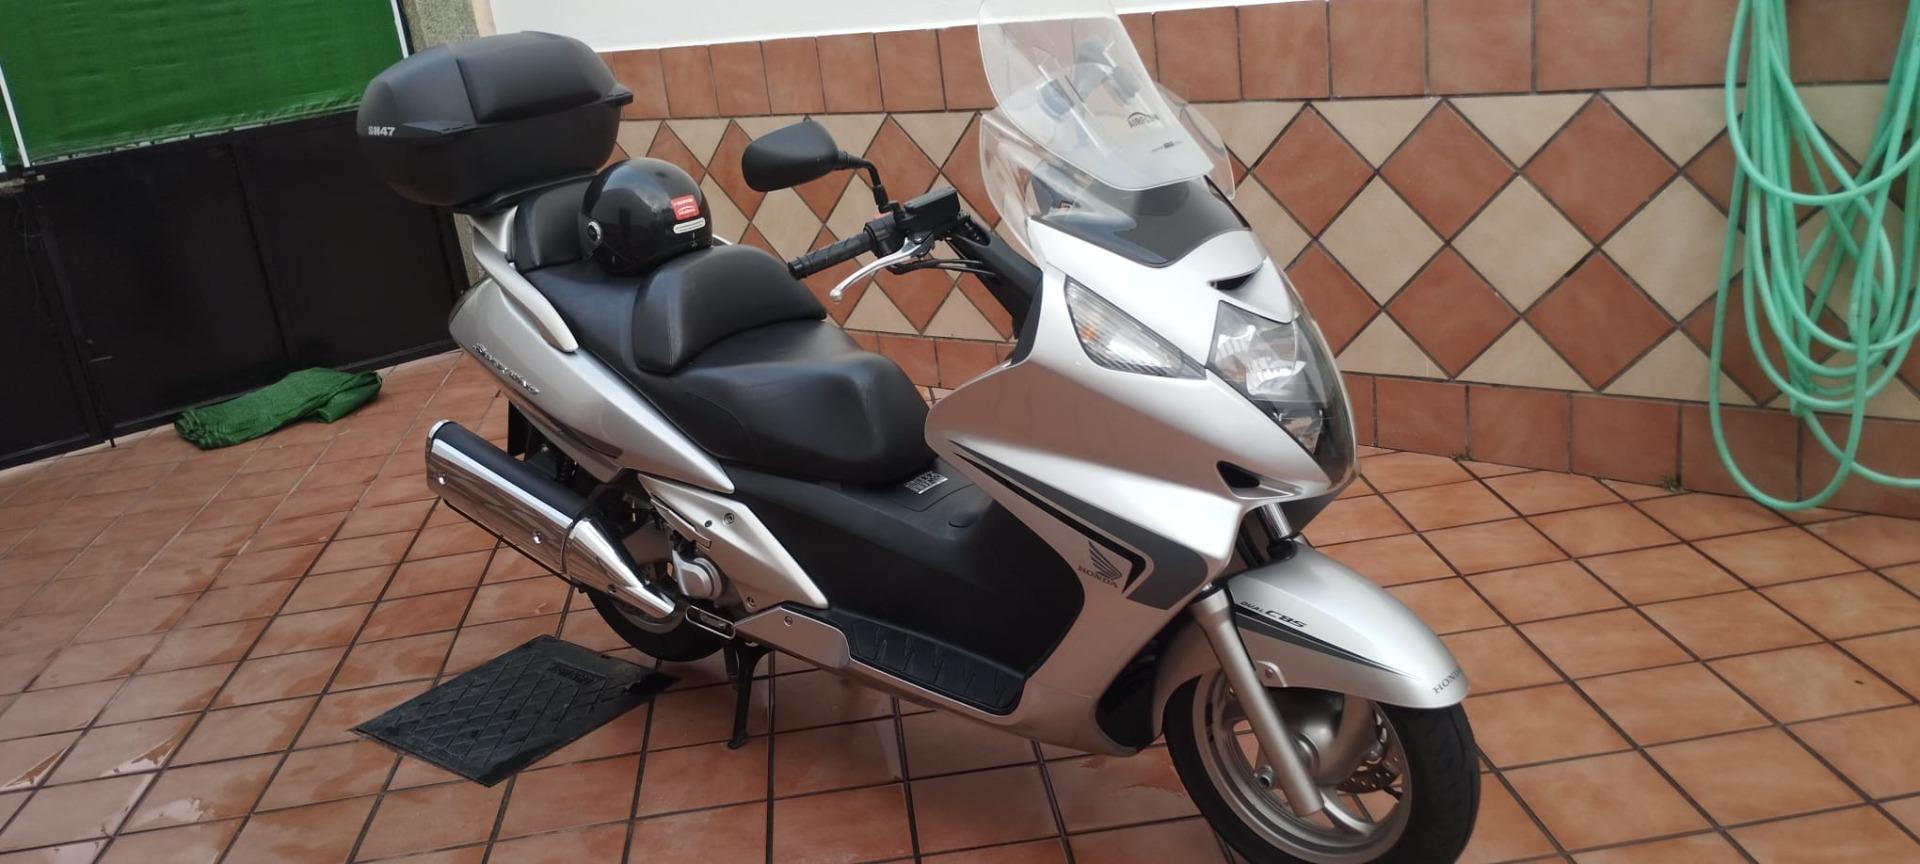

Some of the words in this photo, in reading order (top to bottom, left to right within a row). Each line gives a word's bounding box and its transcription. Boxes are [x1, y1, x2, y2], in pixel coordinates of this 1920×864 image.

[368, 125, 396, 137] SH47
[1078, 565, 1118, 588] HONDA
[1240, 601, 1264, 613] DUAL
[1265, 610, 1308, 627] CBS
